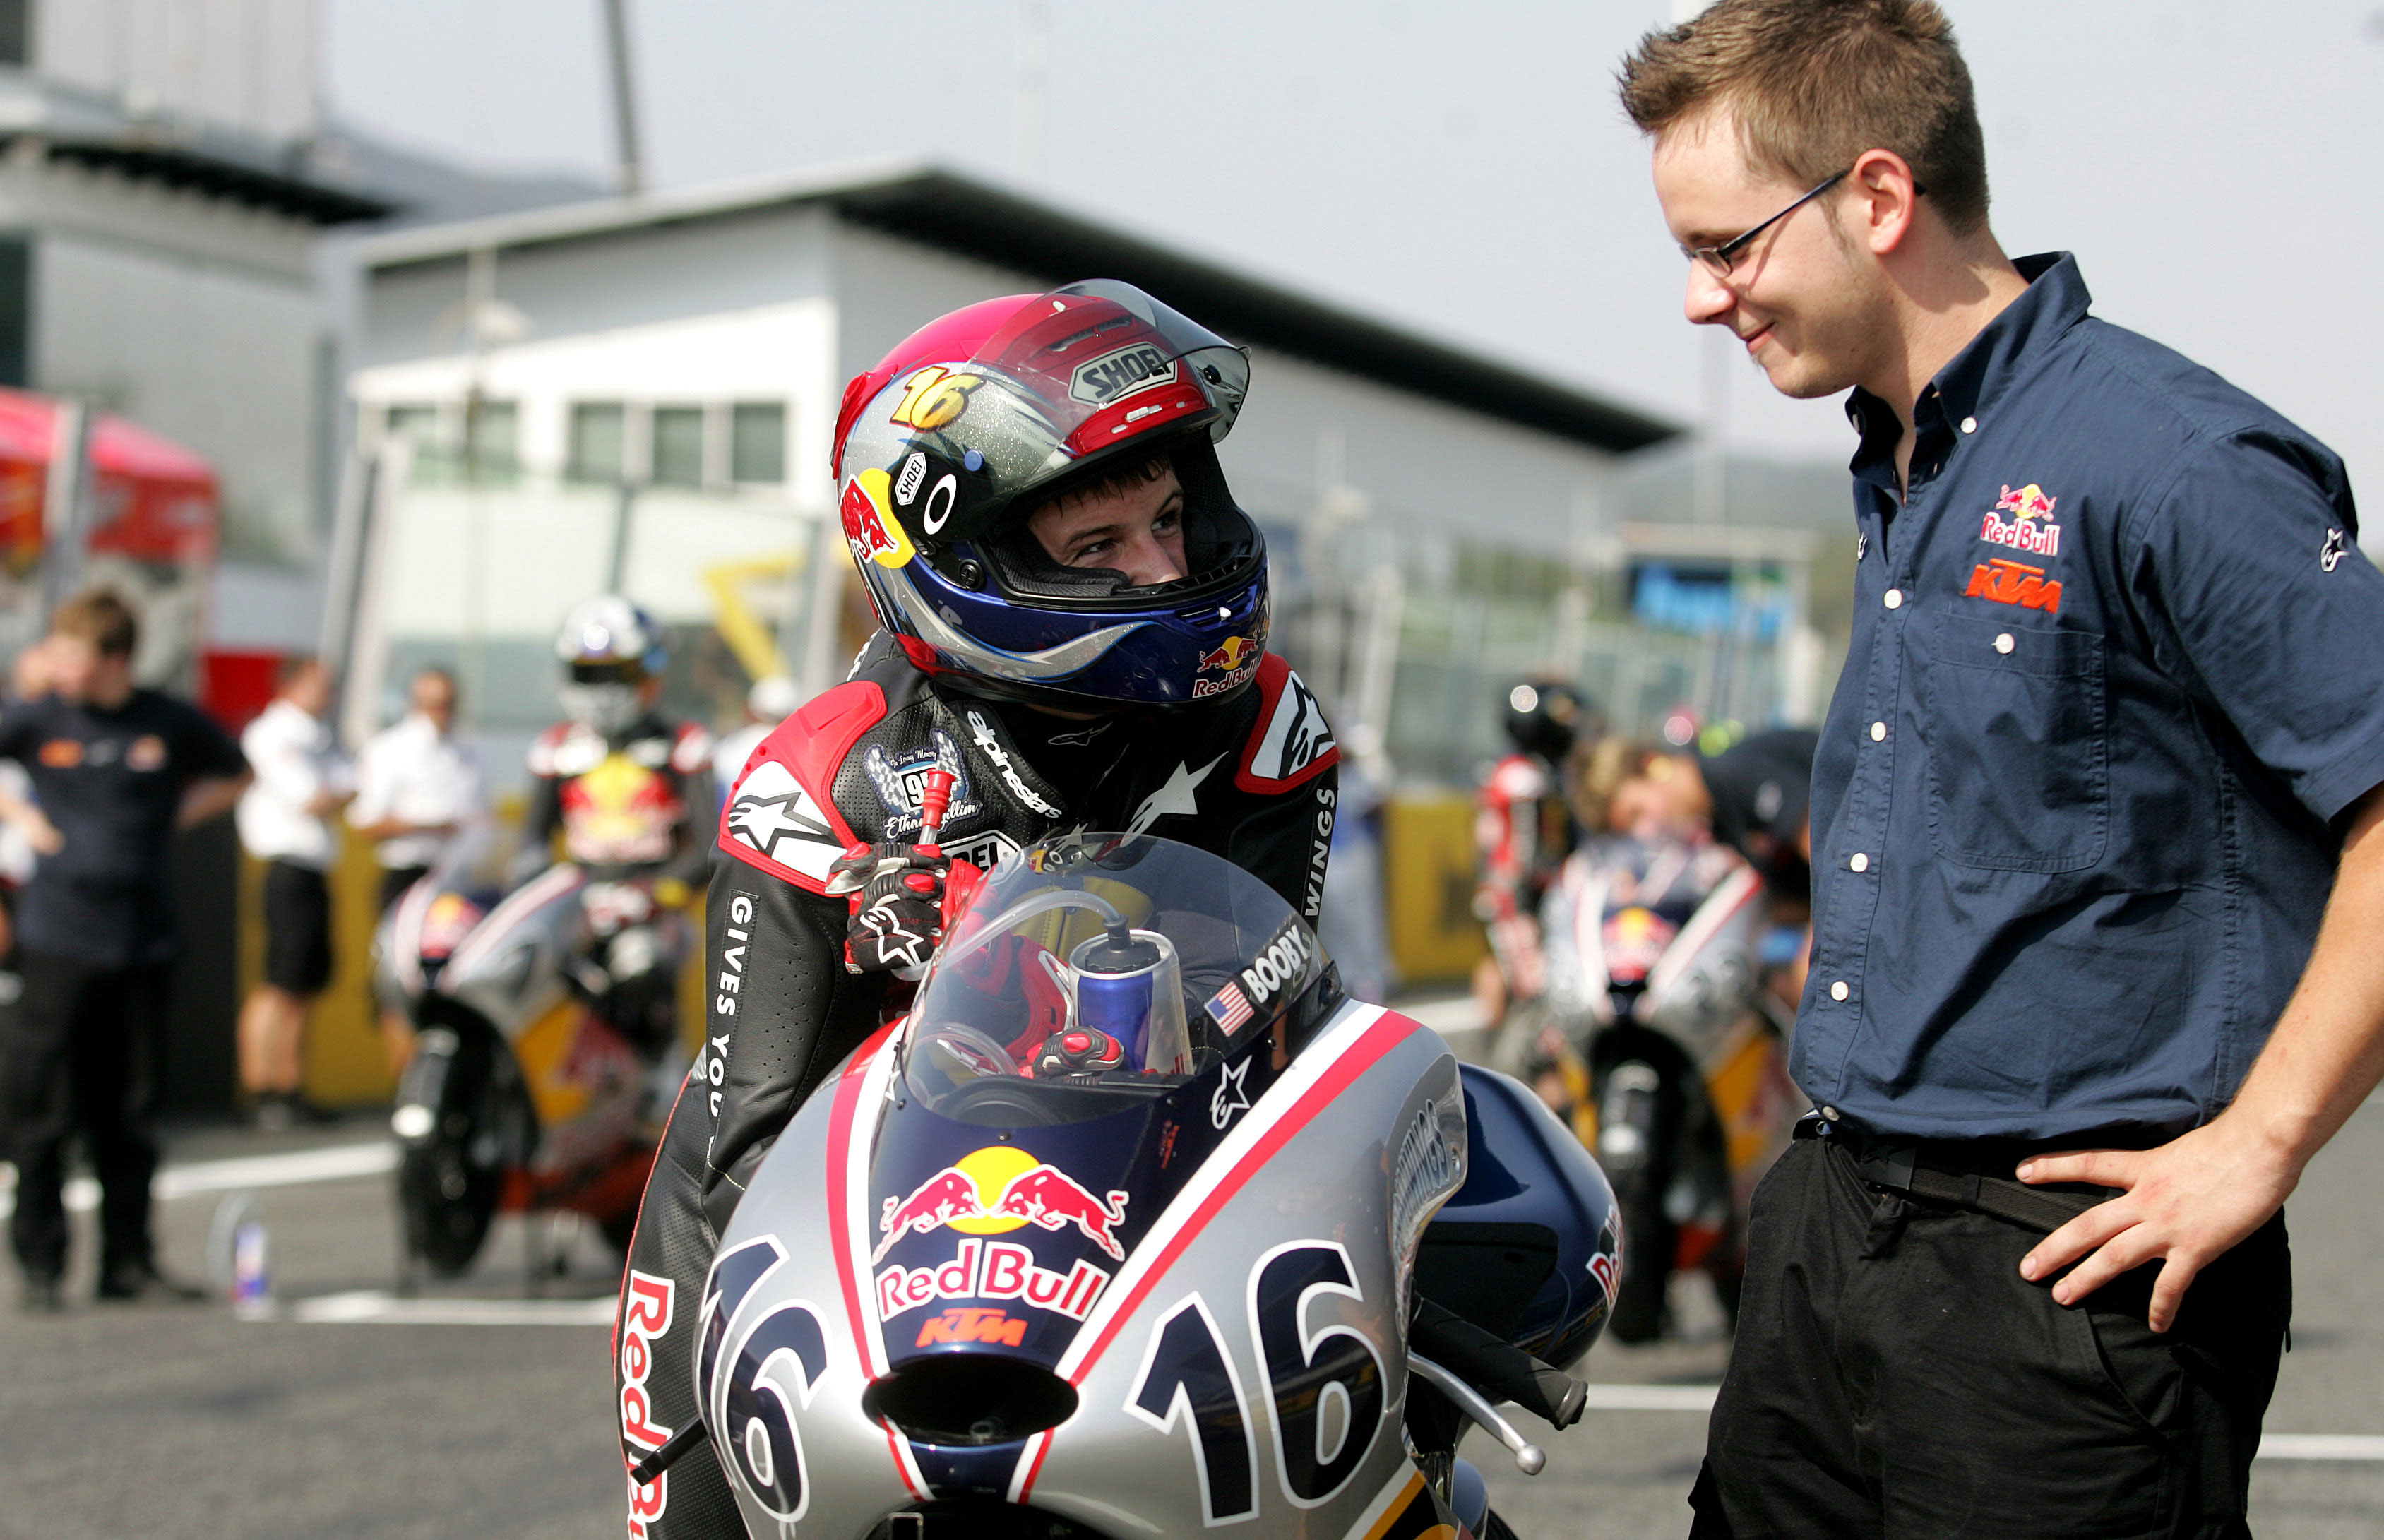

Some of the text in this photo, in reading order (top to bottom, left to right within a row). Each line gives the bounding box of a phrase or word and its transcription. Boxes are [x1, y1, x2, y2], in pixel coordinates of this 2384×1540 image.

[890, 366, 987, 433] 16
[1082, 349, 1171, 398] SHOEI
[900, 460, 922, 499] SHOEI
[1980, 511, 2061, 556] Red Bull
[1966, 558, 2063, 614] KTM
[1193, 657, 1258, 698] Red Bull
[967, 710, 1062, 818] alpinestars
[1304, 787, 1335, 917] WINGS
[1241, 924, 1309, 1003] BOOBY
[709, 896, 753, 1117] GIVES YOU
[875, 1238, 1111, 1322] Red Bull
[621, 1269, 675, 1452] Red
[916, 1308, 1028, 1347] KTM
[693, 1234, 830, 1523] 16
[1122, 1238, 1388, 1528] 16
